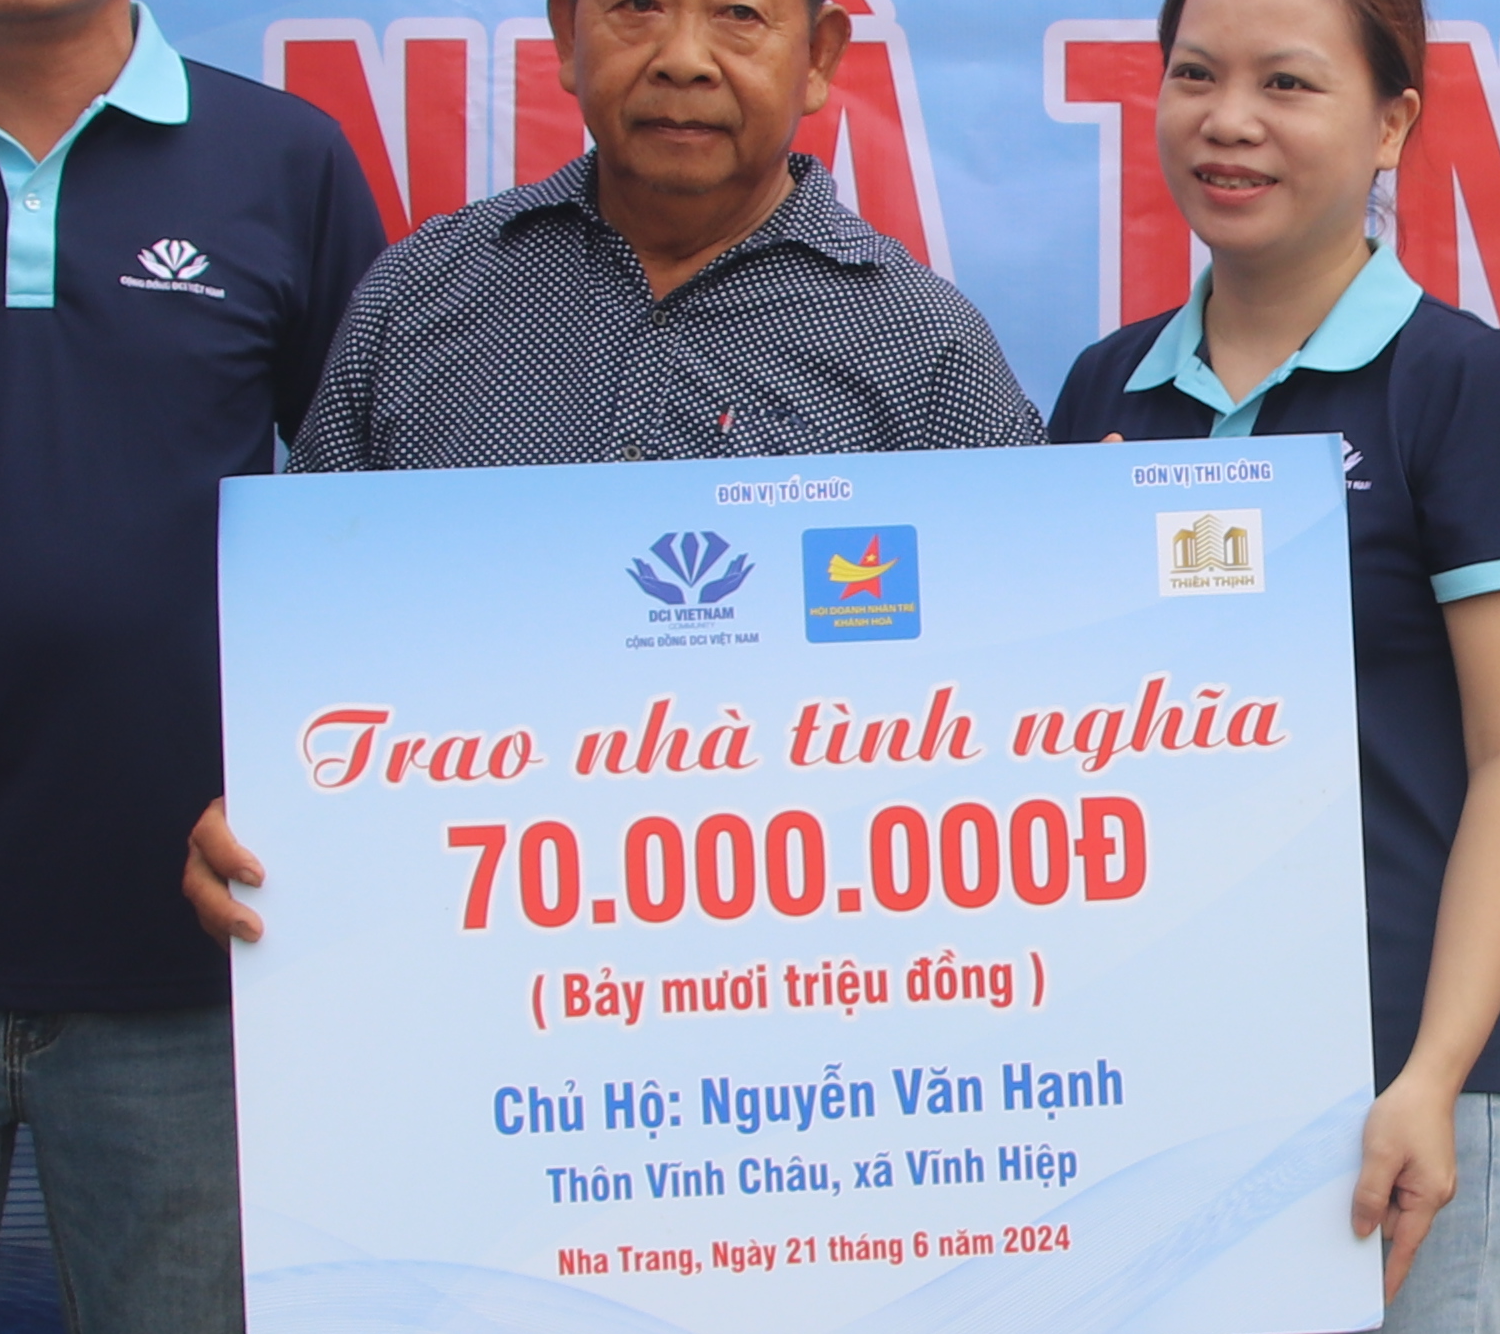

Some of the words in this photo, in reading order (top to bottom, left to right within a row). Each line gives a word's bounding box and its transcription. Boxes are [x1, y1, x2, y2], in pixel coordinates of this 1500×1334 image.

[1135, 467, 1167, 484] ĐƠN
[1173, 467, 1190, 486] VỊ
[1195, 466, 1221, 482] THI
[1227, 460, 1271, 480] CÔNG
[719, 482, 751, 503] ĐƠN
[759, 485, 774, 505] VỊ
[806, 479, 851, 499] CHỨC
[1170, 577, 1209, 588] THIÊN
[1214, 576, 1254, 589] THỊNH
[649, 609, 671, 622] DCI
[675, 607, 734, 621] VIETNAM
[829, 605, 866, 616] DOANH
[834, 616, 870, 628] KHÁNH
[626, 636, 655, 650] CỘNG
[658, 633, 687, 647] ĐỒNG
[690, 635, 706, 646] DCI
[709, 632, 732, 646] VIỆT
[736, 633, 759, 644] NAM
[305, 708, 537, 788] Trao
[575, 698, 751, 777] nhà
[789, 686, 973, 768] tình
[1012, 677, 1279, 773] nghĩa
[447, 794, 1149, 931] 70.000.000Đ
[532, 974, 547, 1030] (
[563, 971, 646, 1027] Bảy
[661, 963, 769, 1014] mươi
[783, 959, 890, 1016] triệu
[906, 949, 1015, 1010] đồng
[1030, 951, 1046, 1007] )
[492, 1079, 585, 1137] Chủ
[602, 1079, 682, 1138] Hộ:
[699, 1062, 877, 1136] Nguyễn
[890, 1066, 984, 1117] Văn
[1001, 1058, 1125, 1121] Hạnh
[544, 1166, 634, 1205] Thôn
[644, 1160, 726, 1201] Vĩnh
[737, 1156, 842, 1197] Châu,
[853, 1151, 894, 1190] xã
[904, 1147, 986, 1187] Vĩnh
[997, 1144, 1079, 1189] Hiệp
[558, 1248, 610, 1276] Nha
[618, 1244, 703, 1277] Trang,
[711, 1241, 777, 1274] Ngày
[787, 1236, 817, 1266] 21
[828, 1237, 905, 1266] tháng
[913, 1230, 930, 1259] 6
[939, 1233, 995, 1257] năm
[1004, 1224, 1072, 1255] 2024
